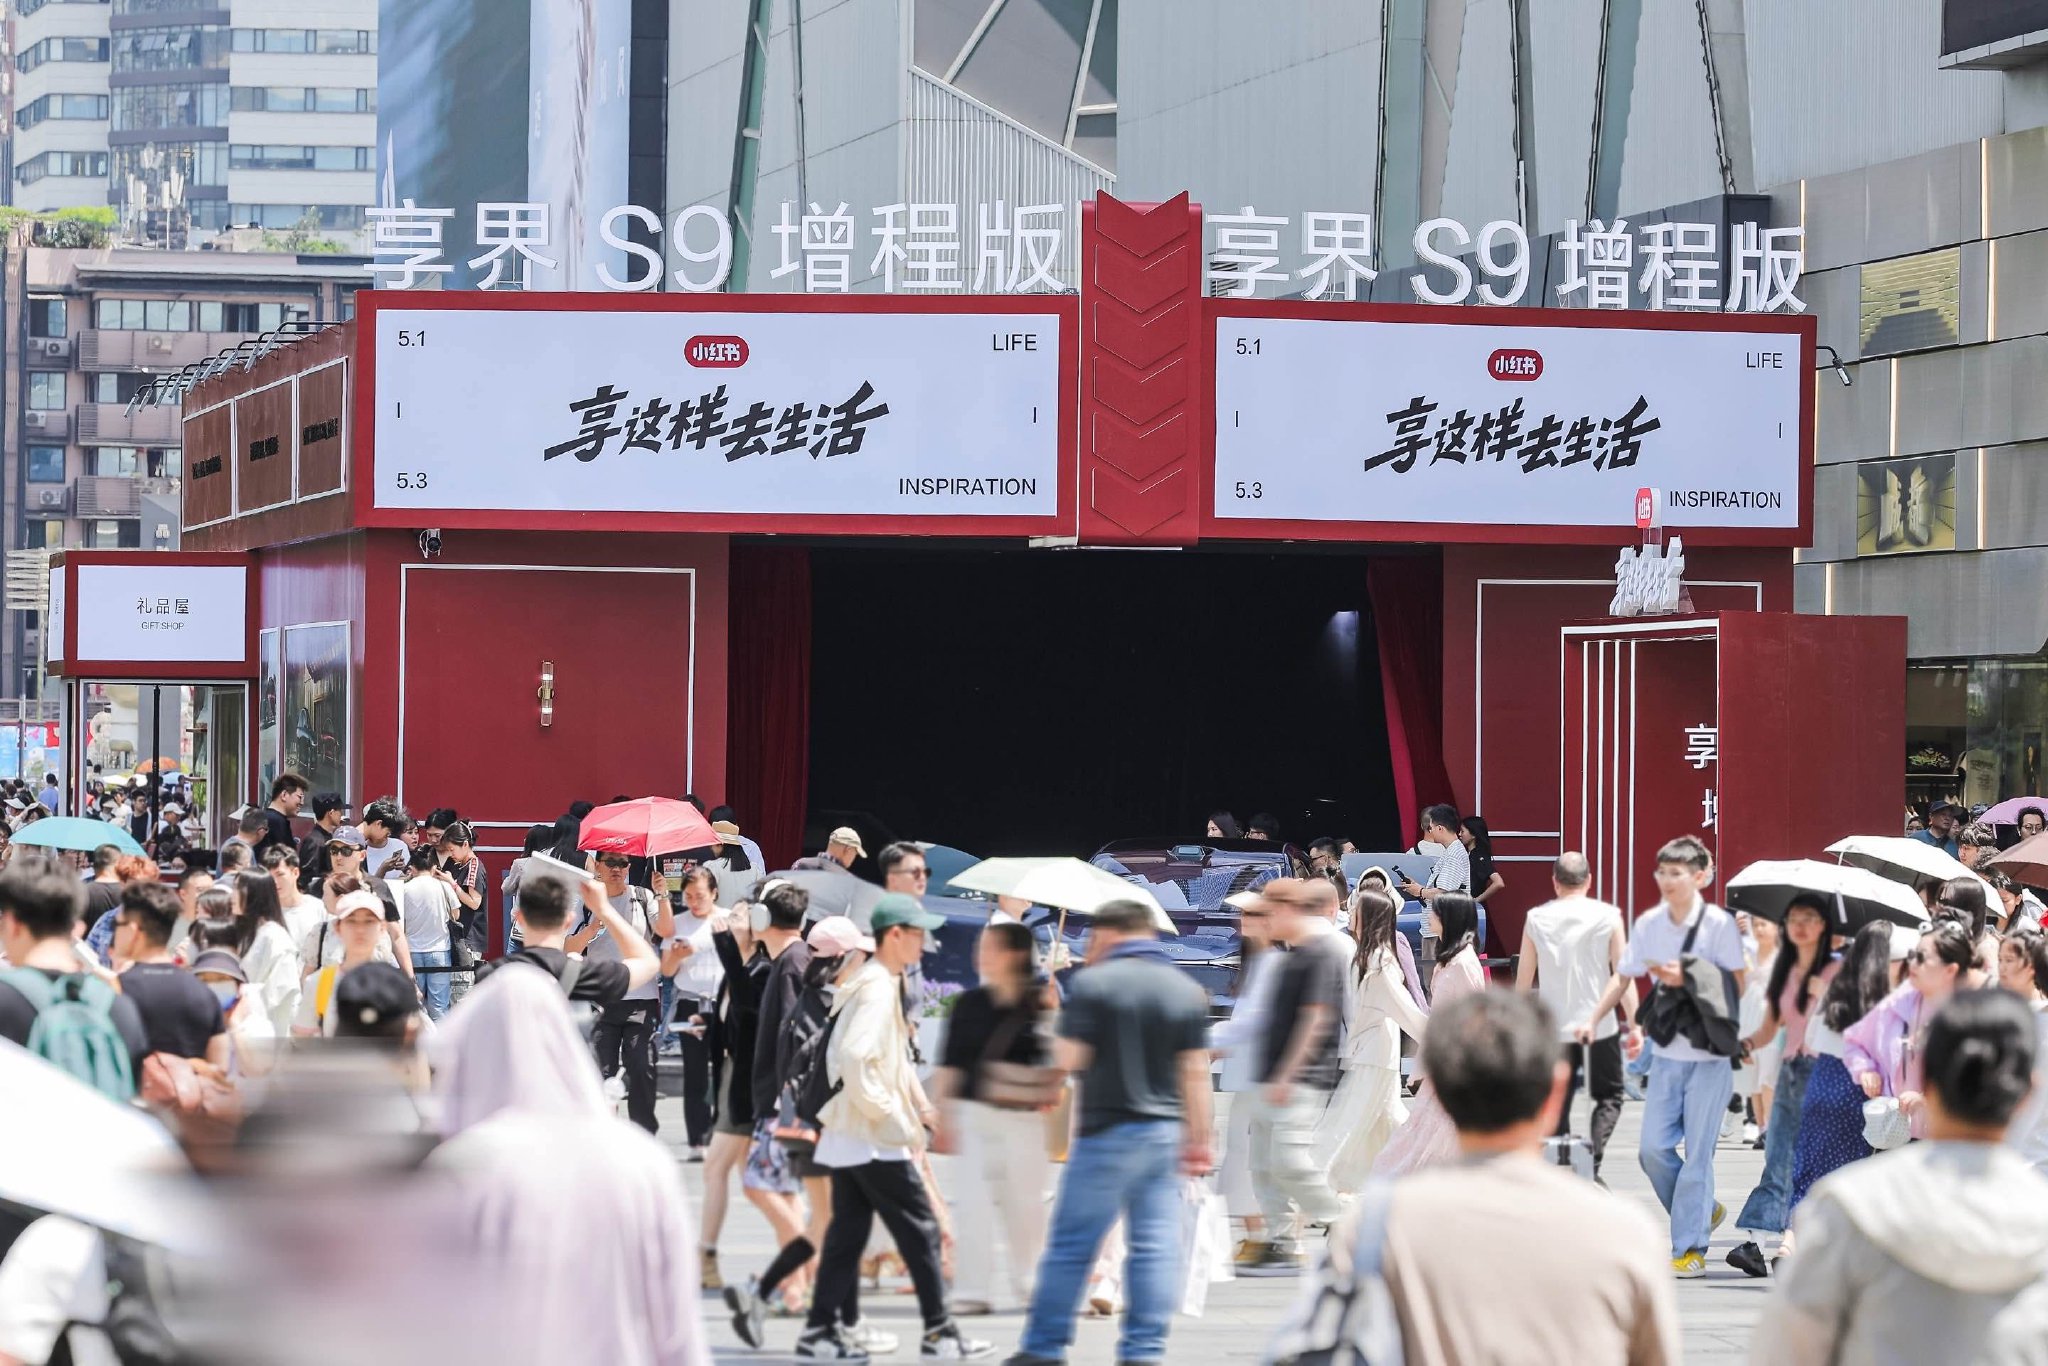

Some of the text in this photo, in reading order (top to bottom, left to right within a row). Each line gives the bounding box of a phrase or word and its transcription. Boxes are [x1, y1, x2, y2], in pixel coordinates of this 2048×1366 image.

[364, 198, 1066, 292] 享界 S9 增程版
[1206, 205, 1808, 313] 享界 S9 增程版
[398, 330, 426, 347] 5.1
[993, 333, 1037, 351] LIFE
[1235, 338, 1261, 355] 5.1
[692, 342, 741, 362] 小红书
[1746, 352, 1783, 369] LIFE
[1494, 355, 1537, 375] 小红书
[543, 380, 890, 463] 享这样去生活
[1364, 394, 1661, 474] 享这样去生活
[396, 472, 428, 490] 5.3
[899, 478, 1036, 496] INSPIRATION
[1235, 481, 1263, 499] 5.3
[1669, 490, 1782, 508] INSPIRATION
[136, 597, 189, 614] 礼品屋
[141, 621, 184, 631] GIFT SHOP
